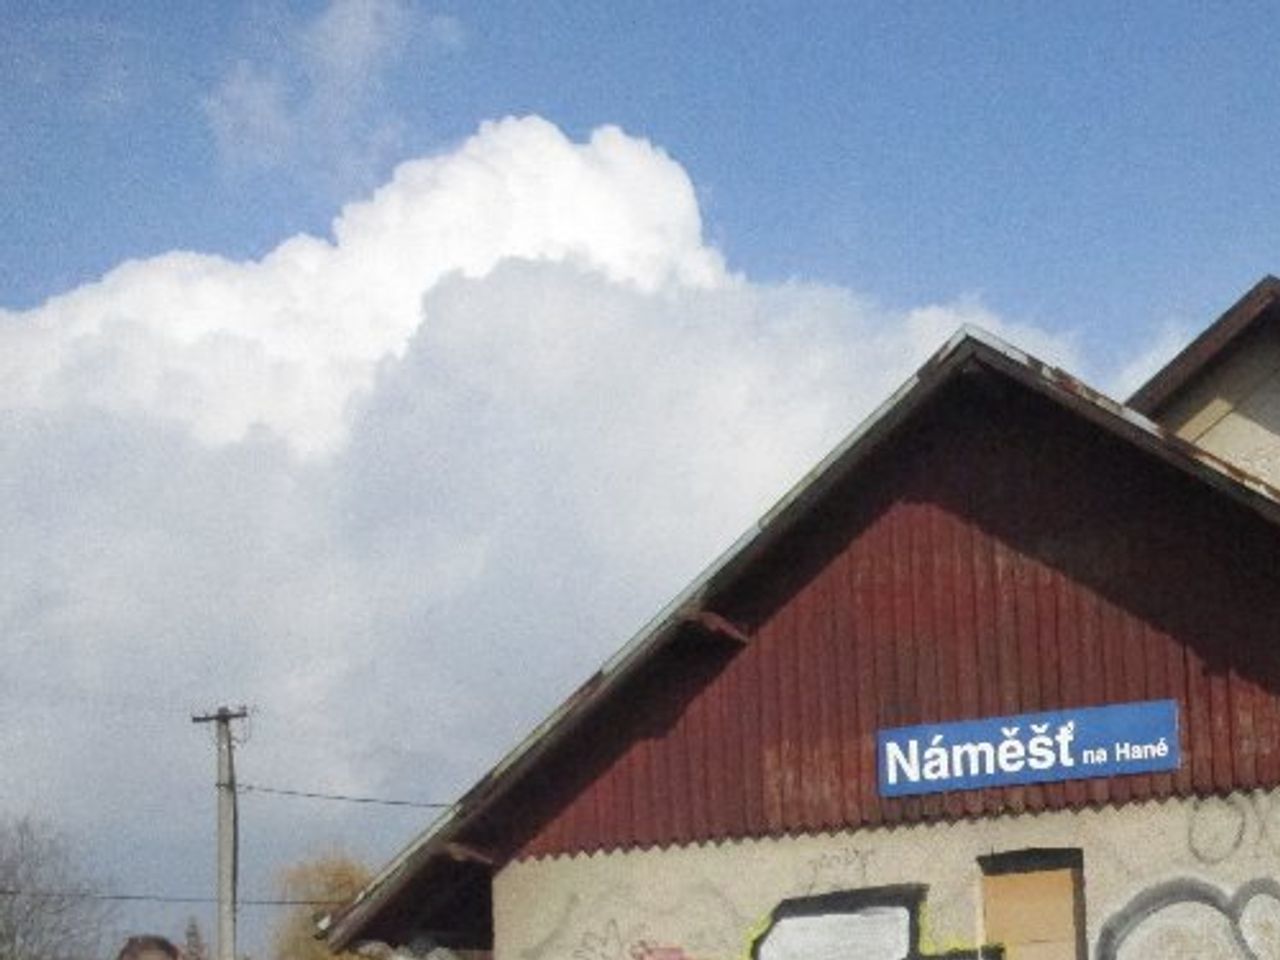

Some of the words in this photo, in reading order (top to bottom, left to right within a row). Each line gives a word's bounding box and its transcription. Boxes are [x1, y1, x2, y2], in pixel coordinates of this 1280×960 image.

[885, 721, 1074, 784] Náměšť
[1082, 747, 1107, 765] na
[1115, 738, 1168, 762] Hané
